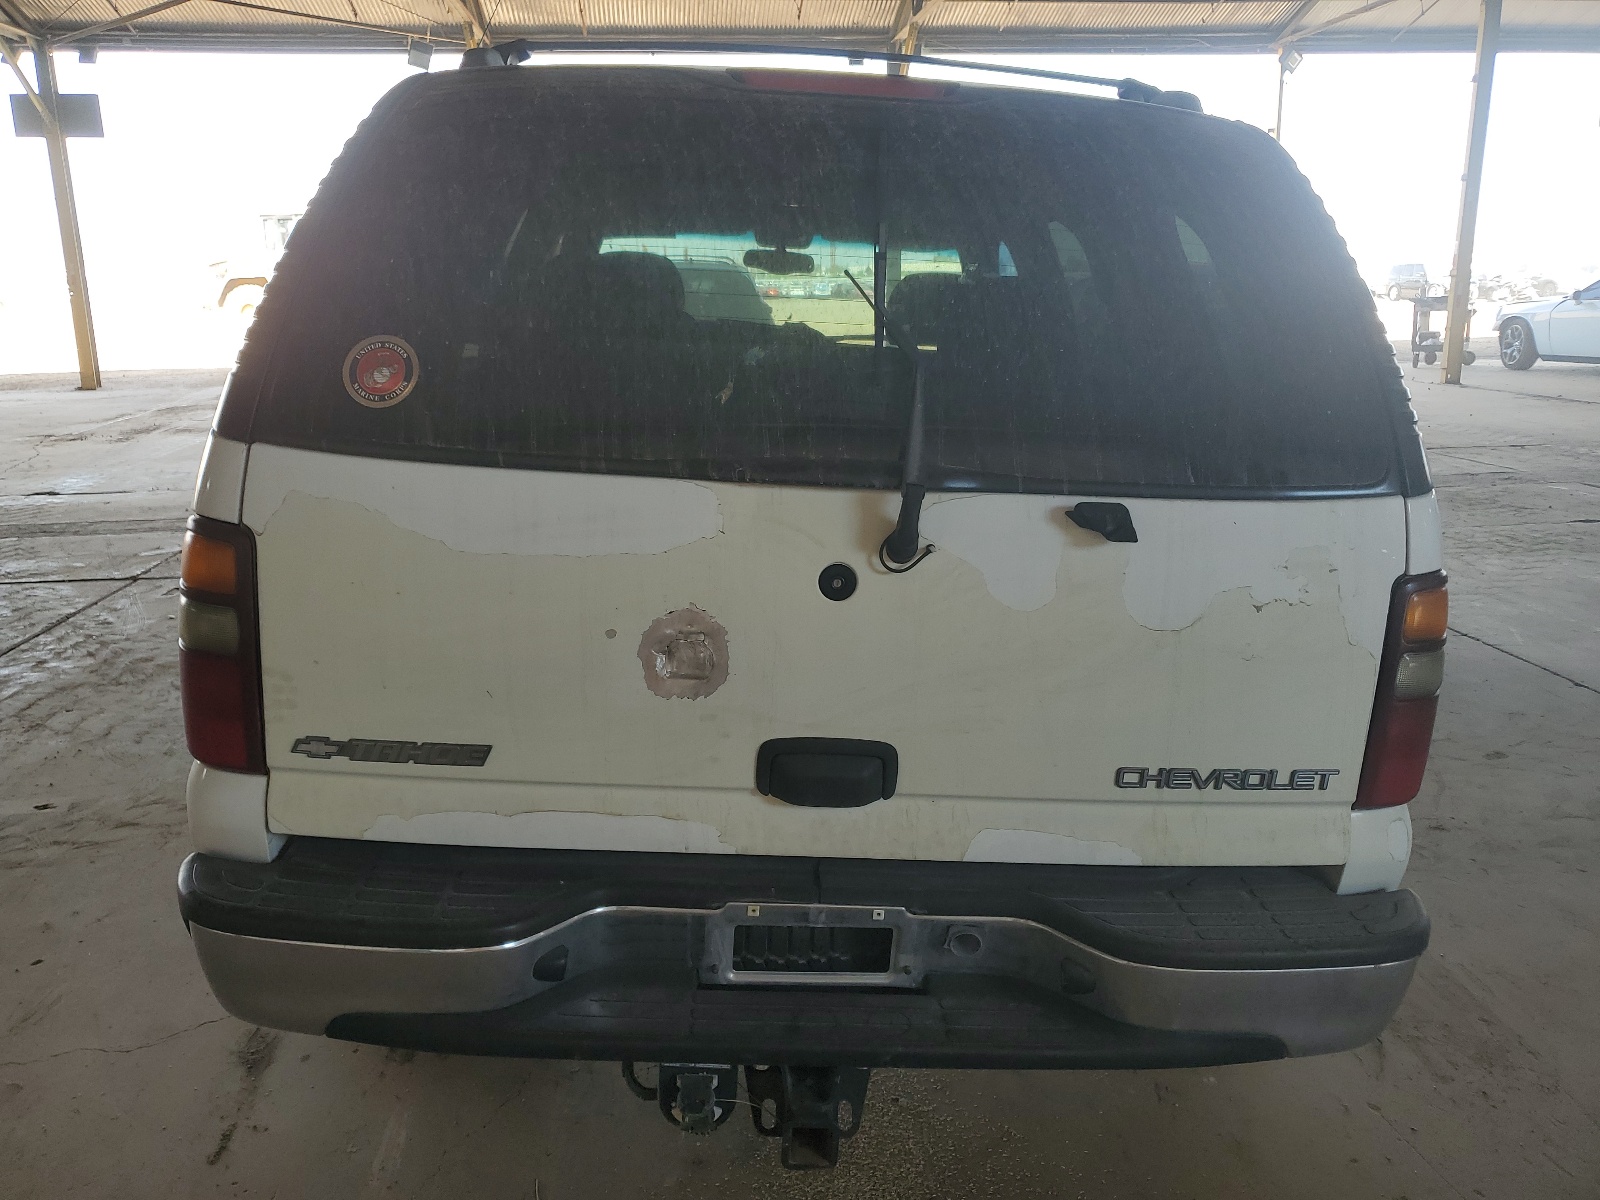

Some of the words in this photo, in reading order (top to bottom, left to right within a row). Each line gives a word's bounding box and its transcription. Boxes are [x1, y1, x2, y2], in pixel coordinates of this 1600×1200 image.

[355, 342, 382, 360] UNITED
[384, 342, 409, 359] STATES
[353, 382, 380, 401] MARINE
[384, 381, 408, 400] CORPS
[349, 738, 493, 767] TAHOE
[1115, 766, 1340, 791] CHEVROLET
